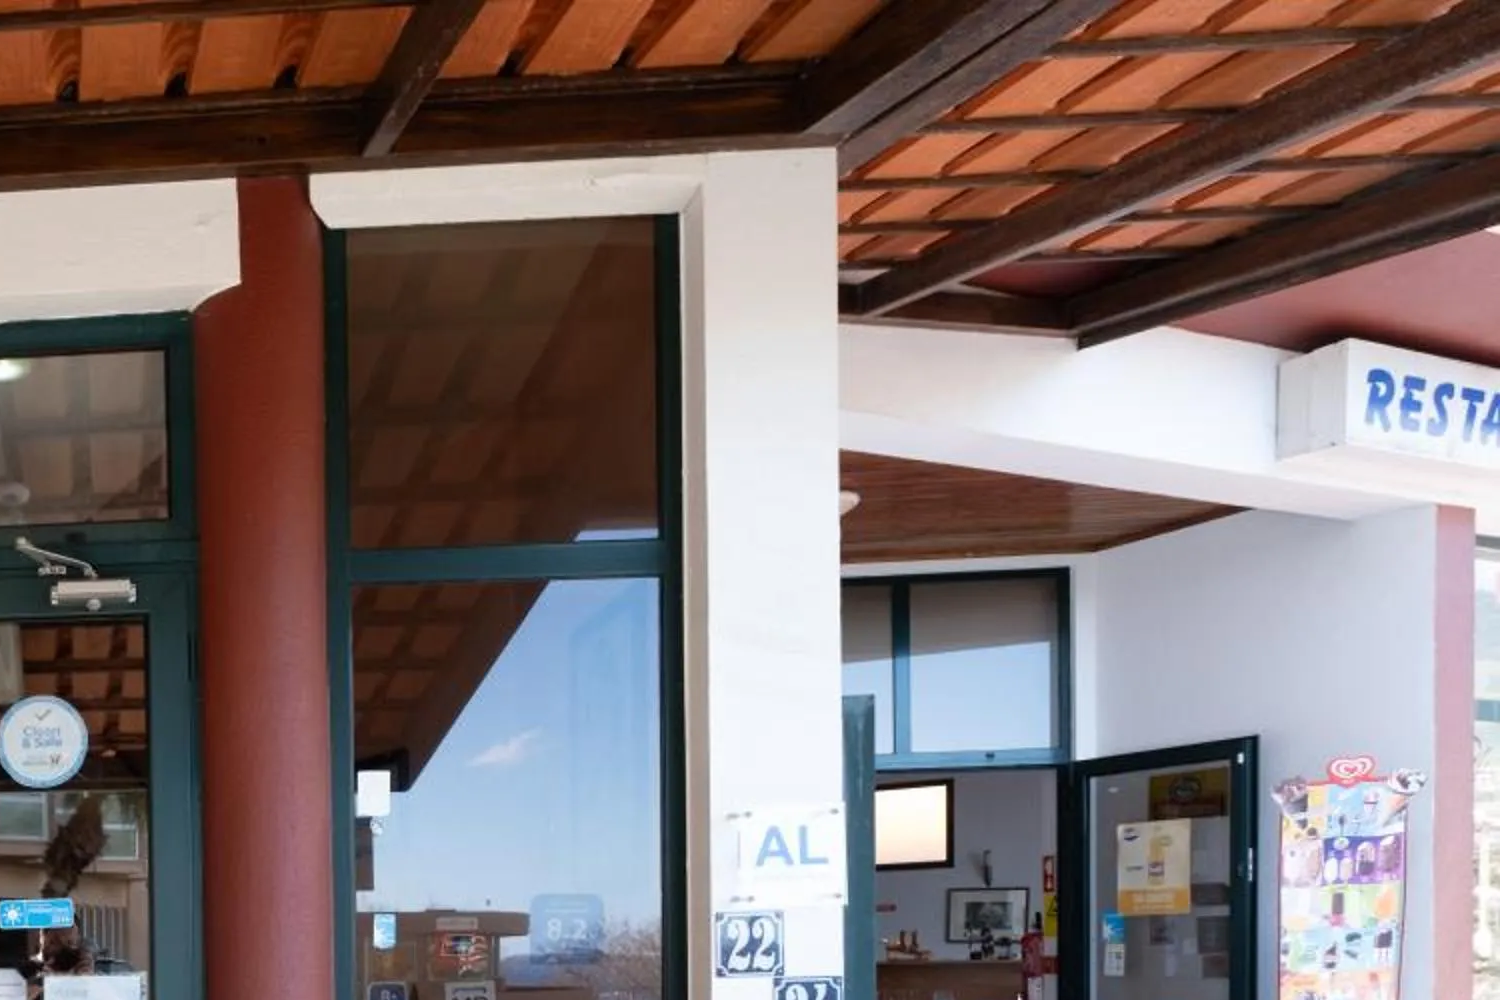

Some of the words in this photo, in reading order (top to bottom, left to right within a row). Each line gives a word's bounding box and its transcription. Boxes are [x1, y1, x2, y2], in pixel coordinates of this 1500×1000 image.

[22, 725, 61, 737] Clean
[755, 824, 830, 868] AL
[726, 918, 777, 972] 22
